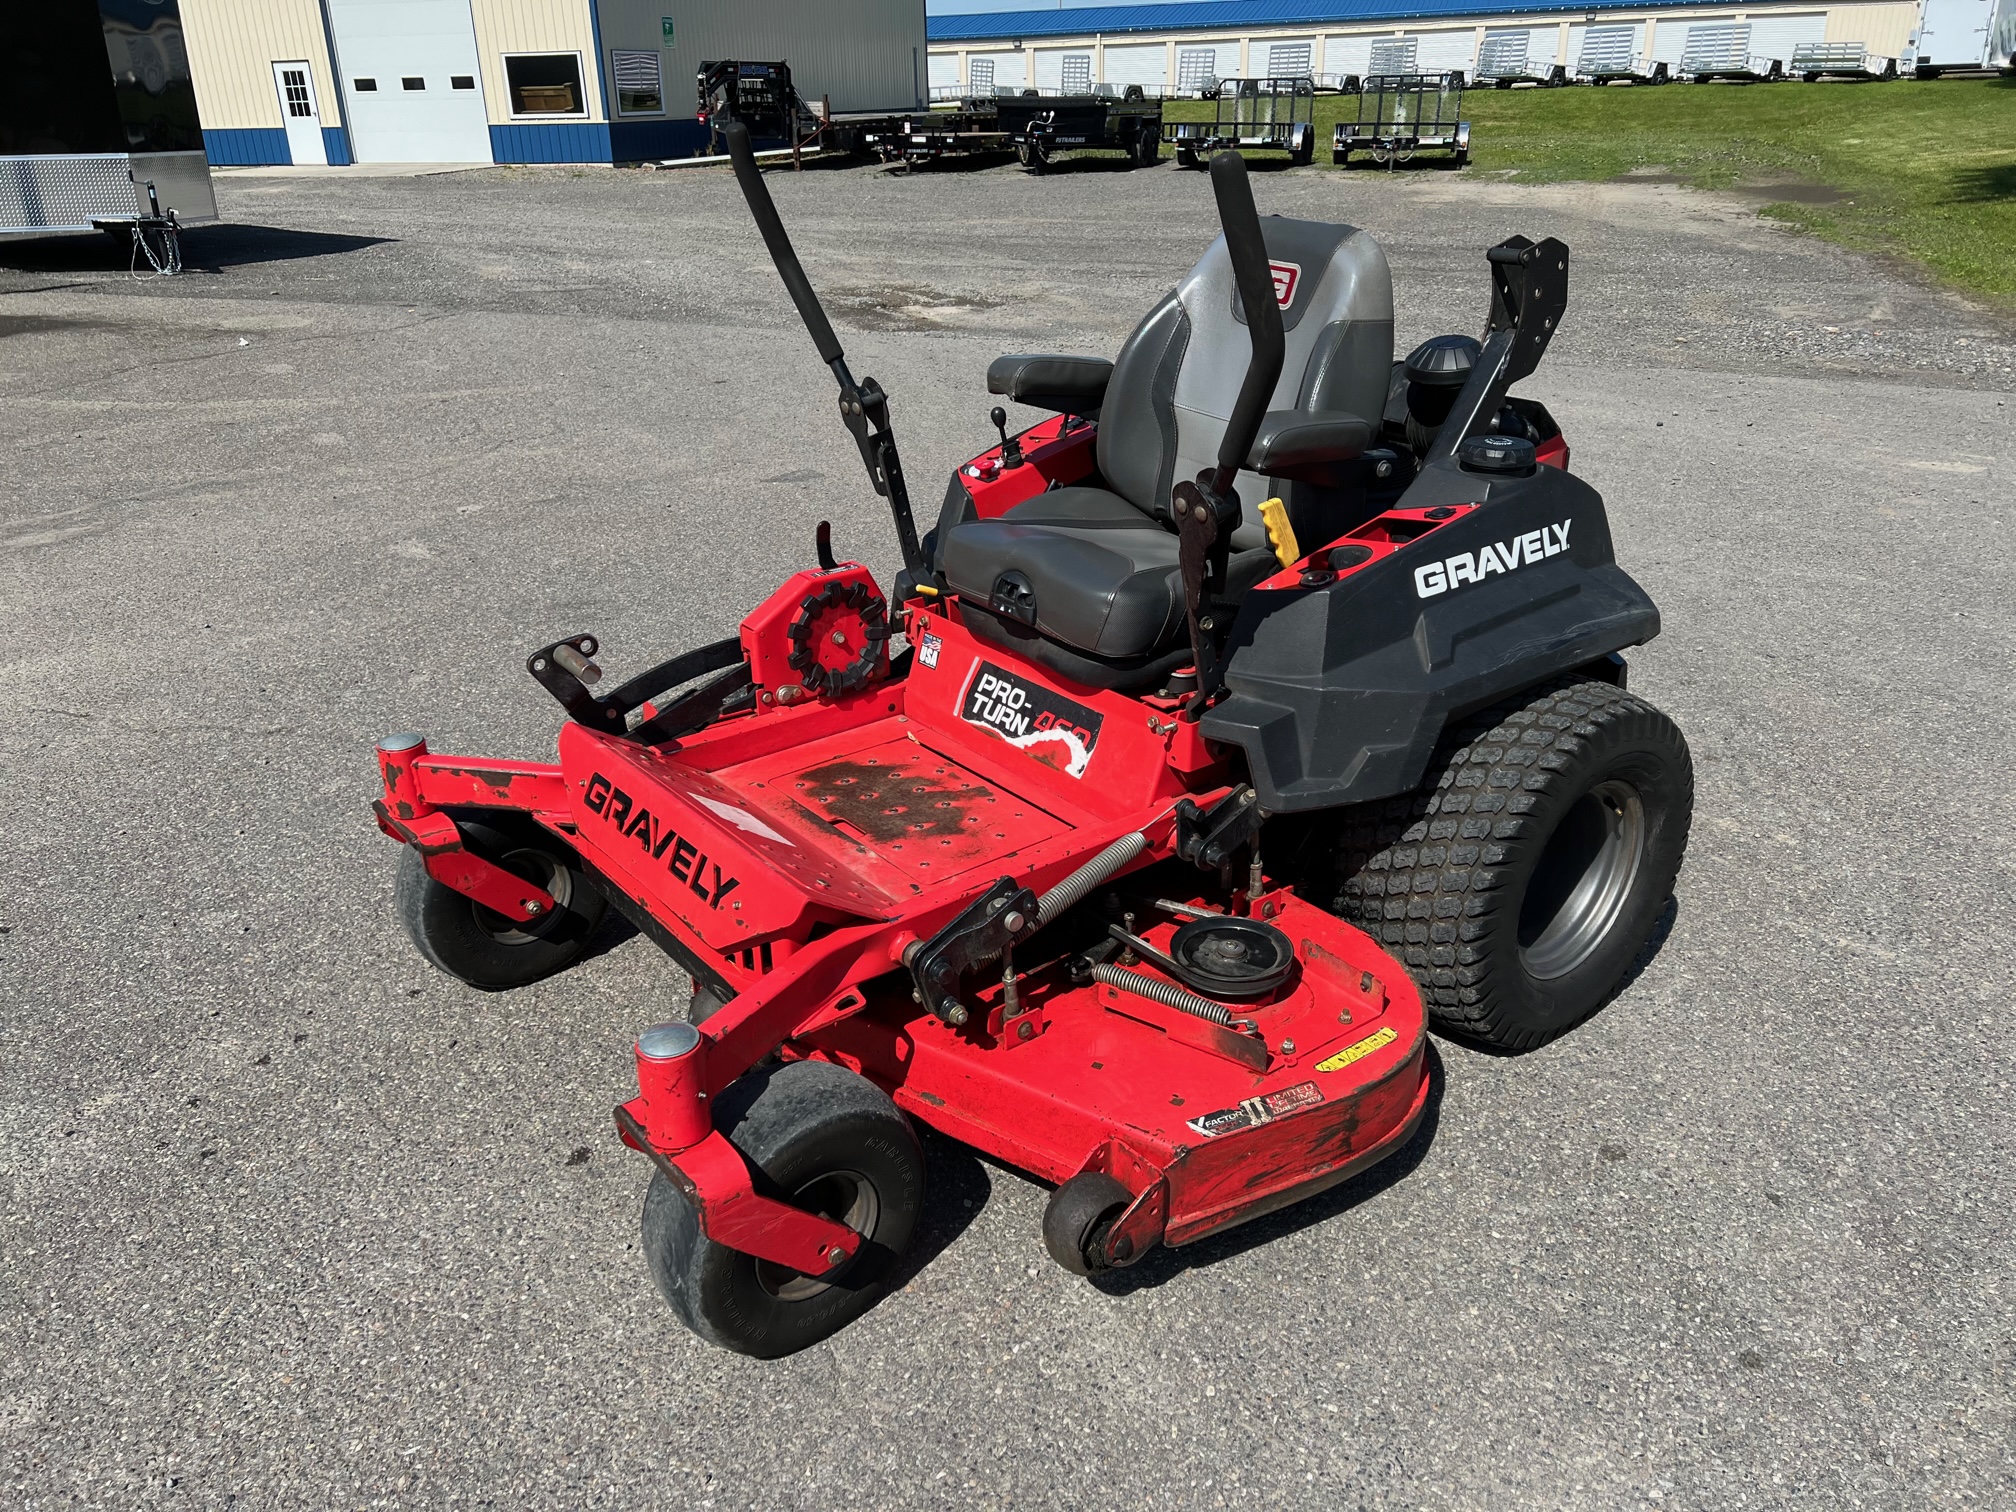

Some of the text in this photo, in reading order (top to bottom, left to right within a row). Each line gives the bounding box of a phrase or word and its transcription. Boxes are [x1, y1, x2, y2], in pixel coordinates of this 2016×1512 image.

[1414, 518, 1572, 599] GRAVELY
[919, 645, 938, 667] USA
[977, 672, 1032, 711] PRO-
[972, 692, 1030, 736] TURN
[584, 771, 740, 911] GRAVELY
[1266, 1083, 1314, 1103] LIMITED
[1205, 1110, 1244, 1128] FACTOR
[864, 1136, 915, 1213] CARLISLE
